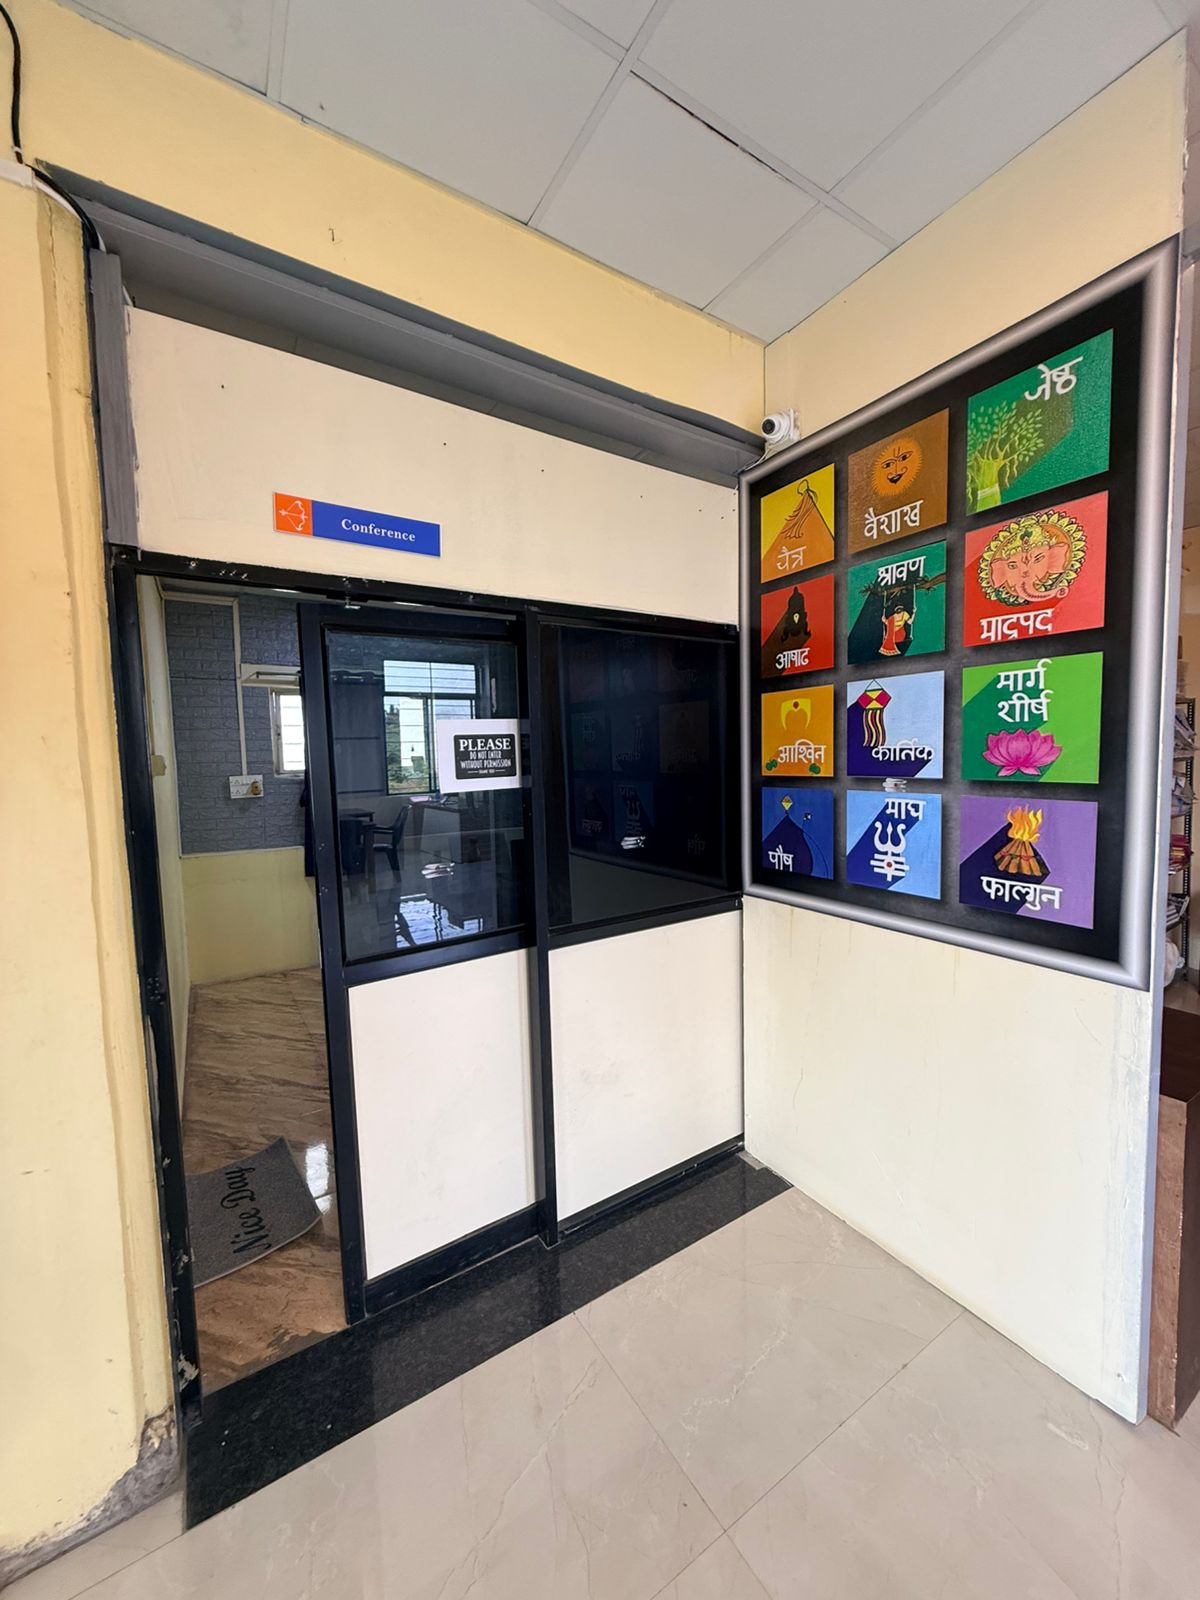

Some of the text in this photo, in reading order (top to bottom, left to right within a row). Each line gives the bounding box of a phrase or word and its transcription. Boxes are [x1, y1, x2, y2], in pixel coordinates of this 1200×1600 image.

[341, 518, 416, 542] Conference
[864, 500, 924, 540] वैशाख
[877, 556, 926, 587] श्रावण
[996, 658, 1052, 692] मार्ग
[997, 689, 1054, 723] शीर्ष
[459, 738, 511, 751] PLEASE
[470, 751, 477, 759] DO
[478, 751, 487, 759] NOT
[871, 738, 935, 762] कार्तिक
[461, 759, 511, 768] WITHOUT PERMISSION
[884, 798, 927, 821] माघ
[768, 844, 795, 872] पौष
[980, 876, 1063, 911] फाल्गुन
[220, 1166, 272, 1254] Nice Day
